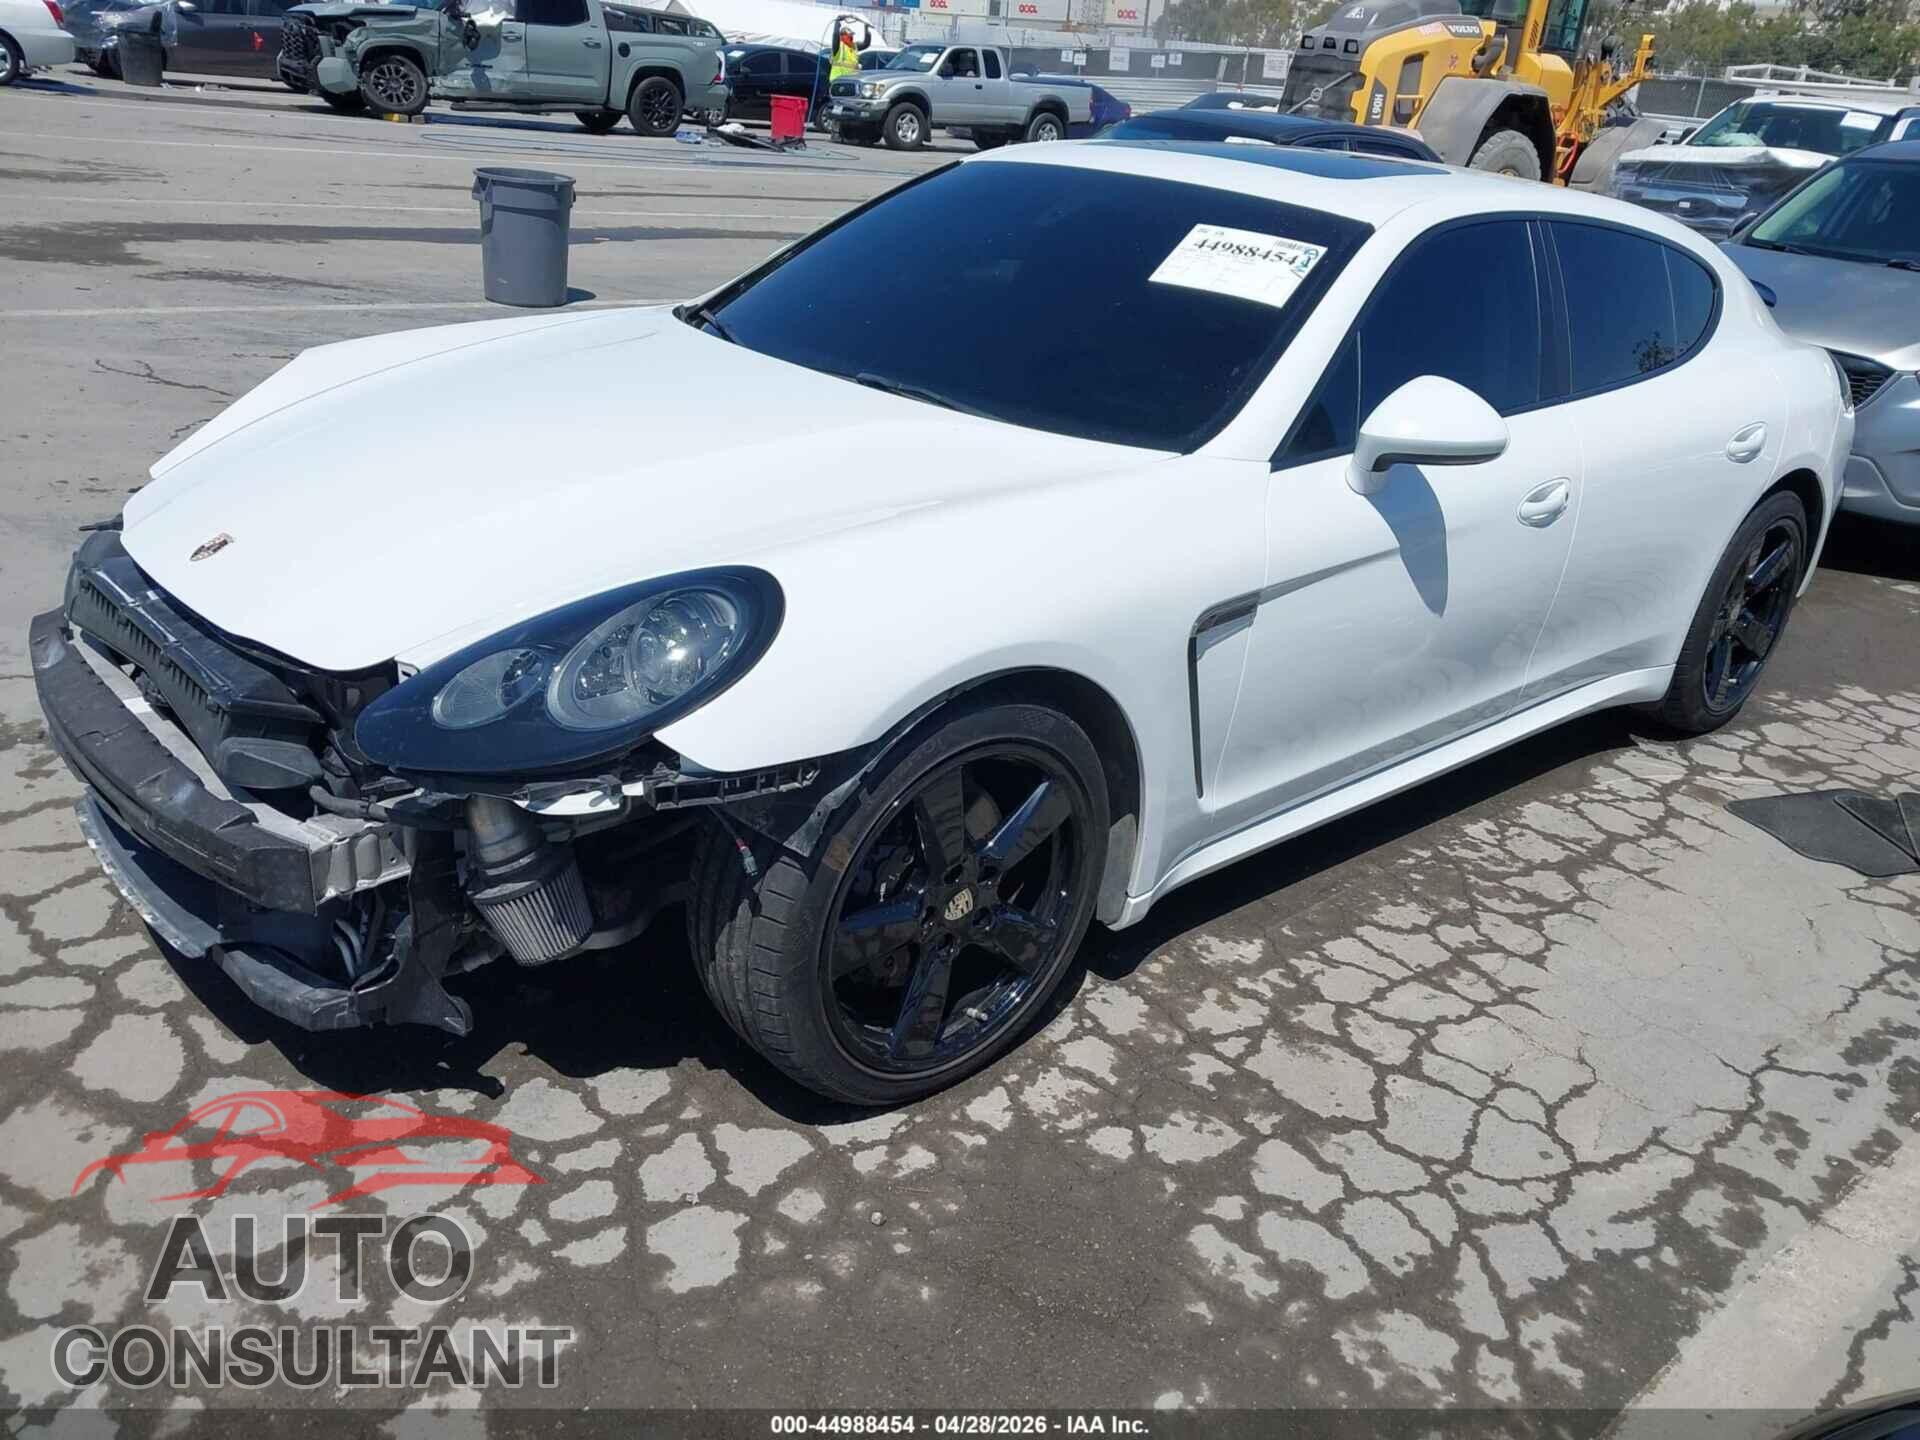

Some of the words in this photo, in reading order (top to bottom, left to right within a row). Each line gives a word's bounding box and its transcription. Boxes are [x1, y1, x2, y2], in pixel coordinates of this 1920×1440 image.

[1019, 4, 1038, 14] OOCL
[1448, 24, 1480, 34] VOLVO
[1371, 94, 1385, 119] L90H
[1193, 238, 1298, 265] 44988454
